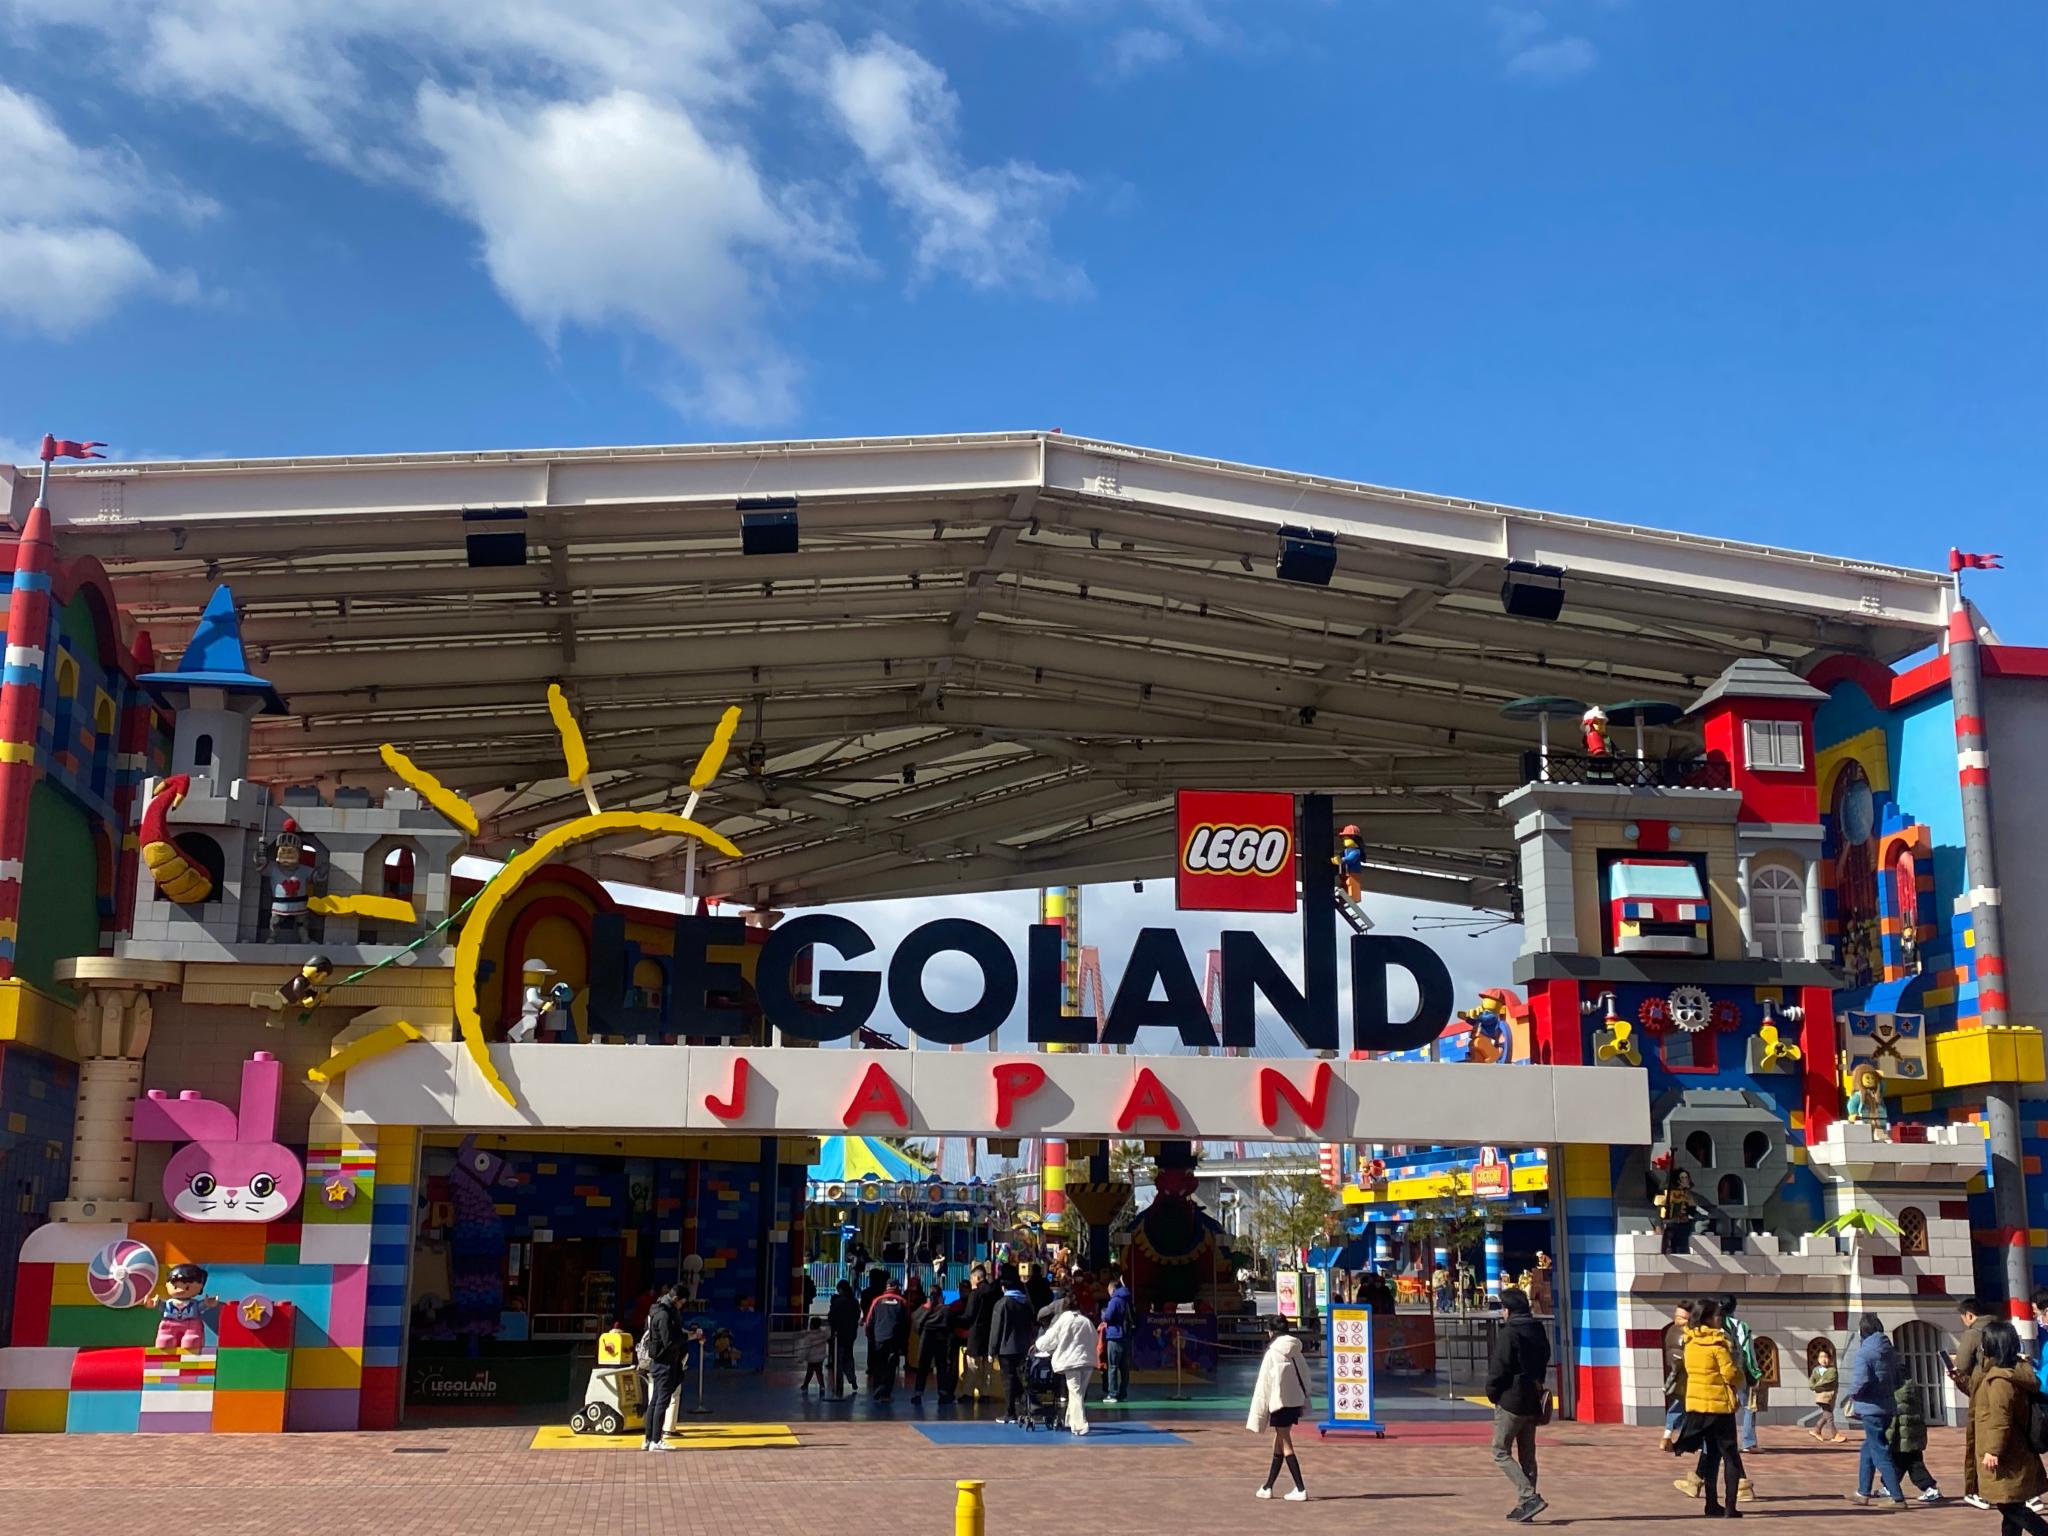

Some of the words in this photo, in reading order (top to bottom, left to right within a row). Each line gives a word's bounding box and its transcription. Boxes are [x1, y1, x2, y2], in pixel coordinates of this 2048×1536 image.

[1187, 828, 1287, 872] LEGO
[588, 795, 1454, 1050] LEGOLAND
[704, 1057, 1333, 1131] JAPAN
[431, 1370, 497, 1391] LEGOLAND
